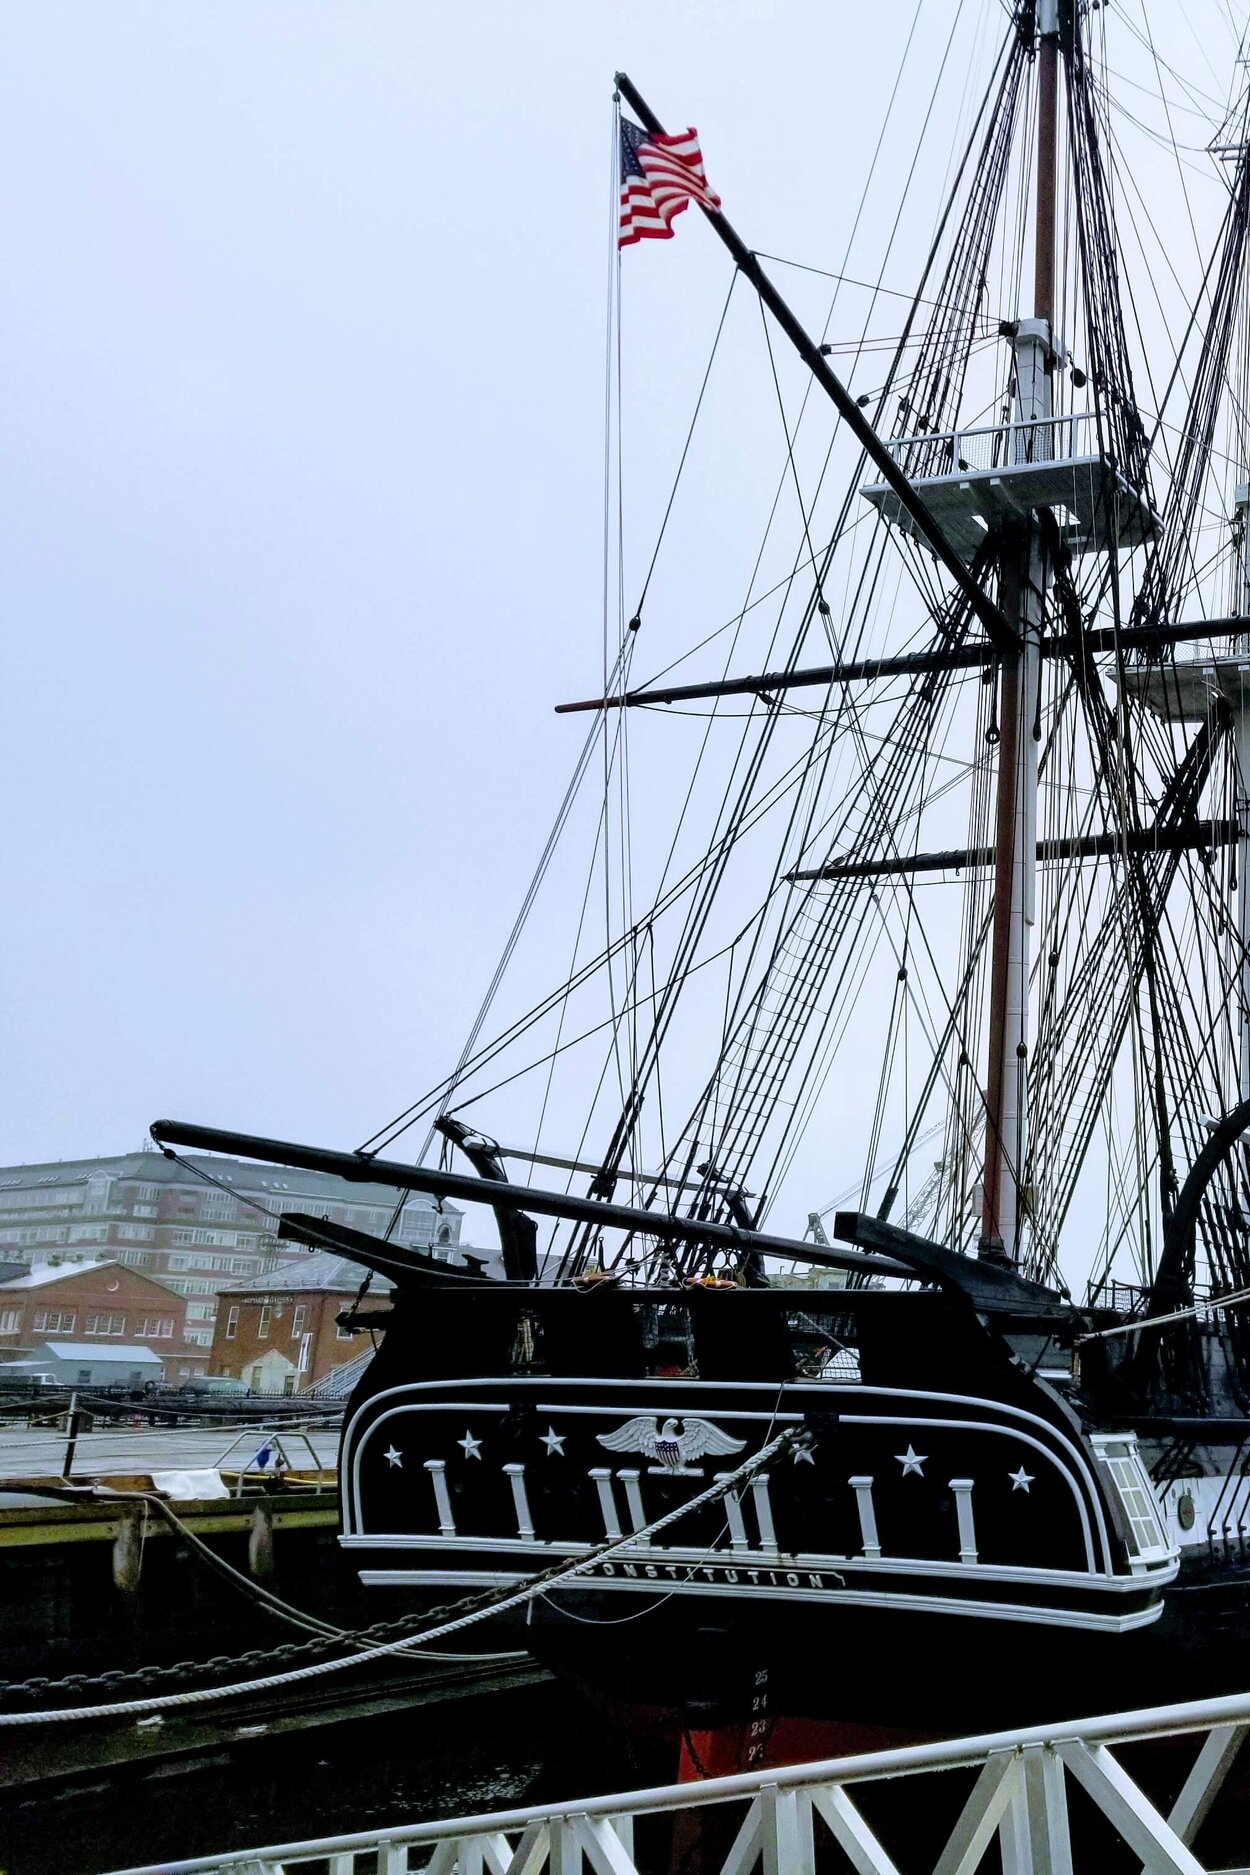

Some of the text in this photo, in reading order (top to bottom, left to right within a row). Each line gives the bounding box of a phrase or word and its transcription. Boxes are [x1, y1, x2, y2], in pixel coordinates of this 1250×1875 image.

[755, 1669, 768, 1685] 25
[752, 1694, 767, 1710] 24
[751, 1719, 766, 1736] 23
